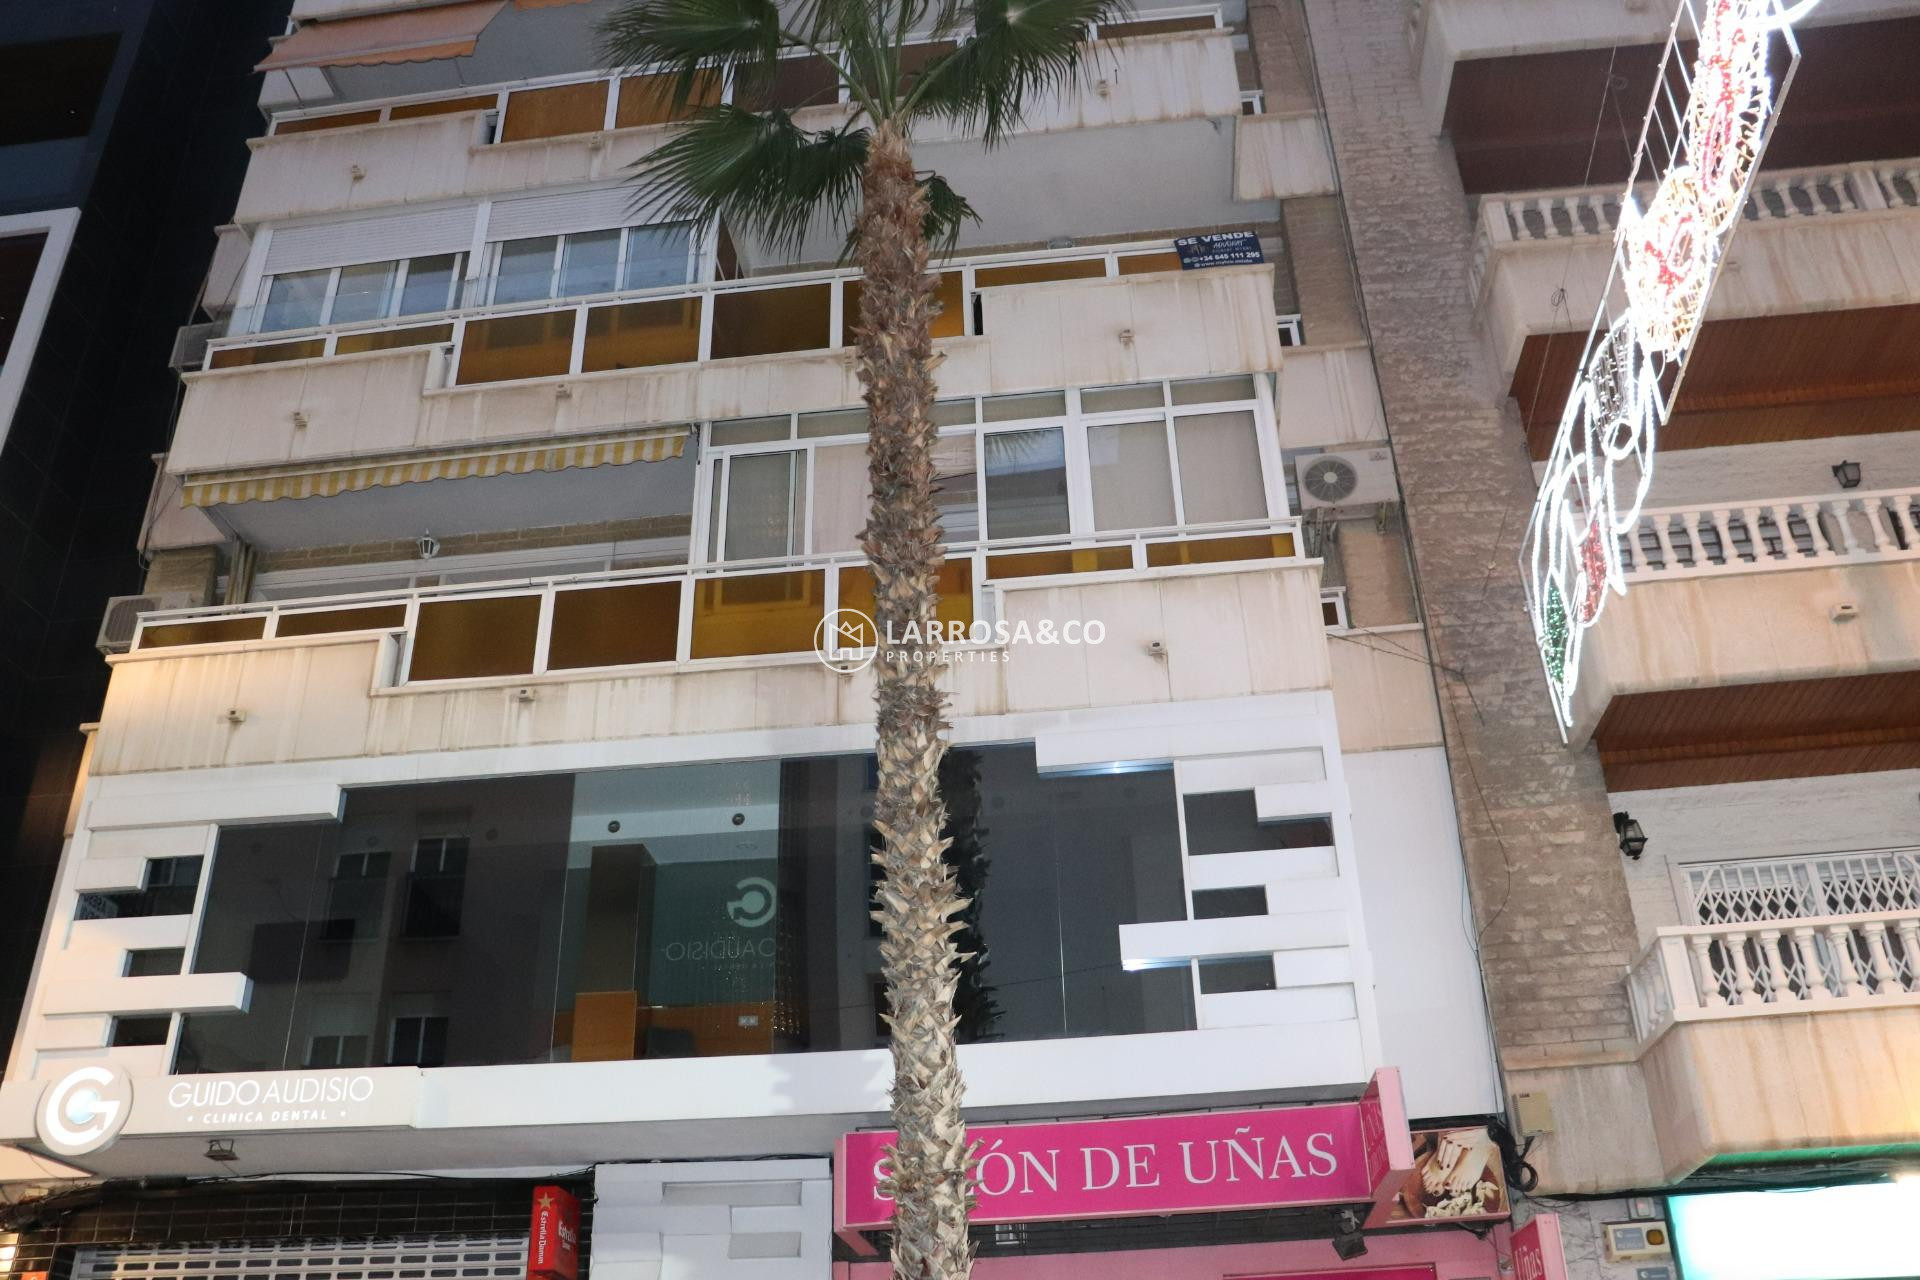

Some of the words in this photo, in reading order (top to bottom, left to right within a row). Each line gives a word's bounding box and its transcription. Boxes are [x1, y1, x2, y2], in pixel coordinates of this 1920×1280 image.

[1177, 238, 1198, 246] SE
[1201, 231, 1255, 243] VENDE
[168, 1079, 260, 1108] GUIDO
[262, 1075, 374, 1105] AUDISIO
[203, 1111, 264, 1125] CLINICA
[271, 1109, 328, 1122] DENTAL
[873, 1138, 1060, 1201] SÓN
[1081, 1143, 1160, 1191] DE
[1178, 1126, 1338, 1184] UÑAS
[539, 1210, 549, 1240] Estrella
